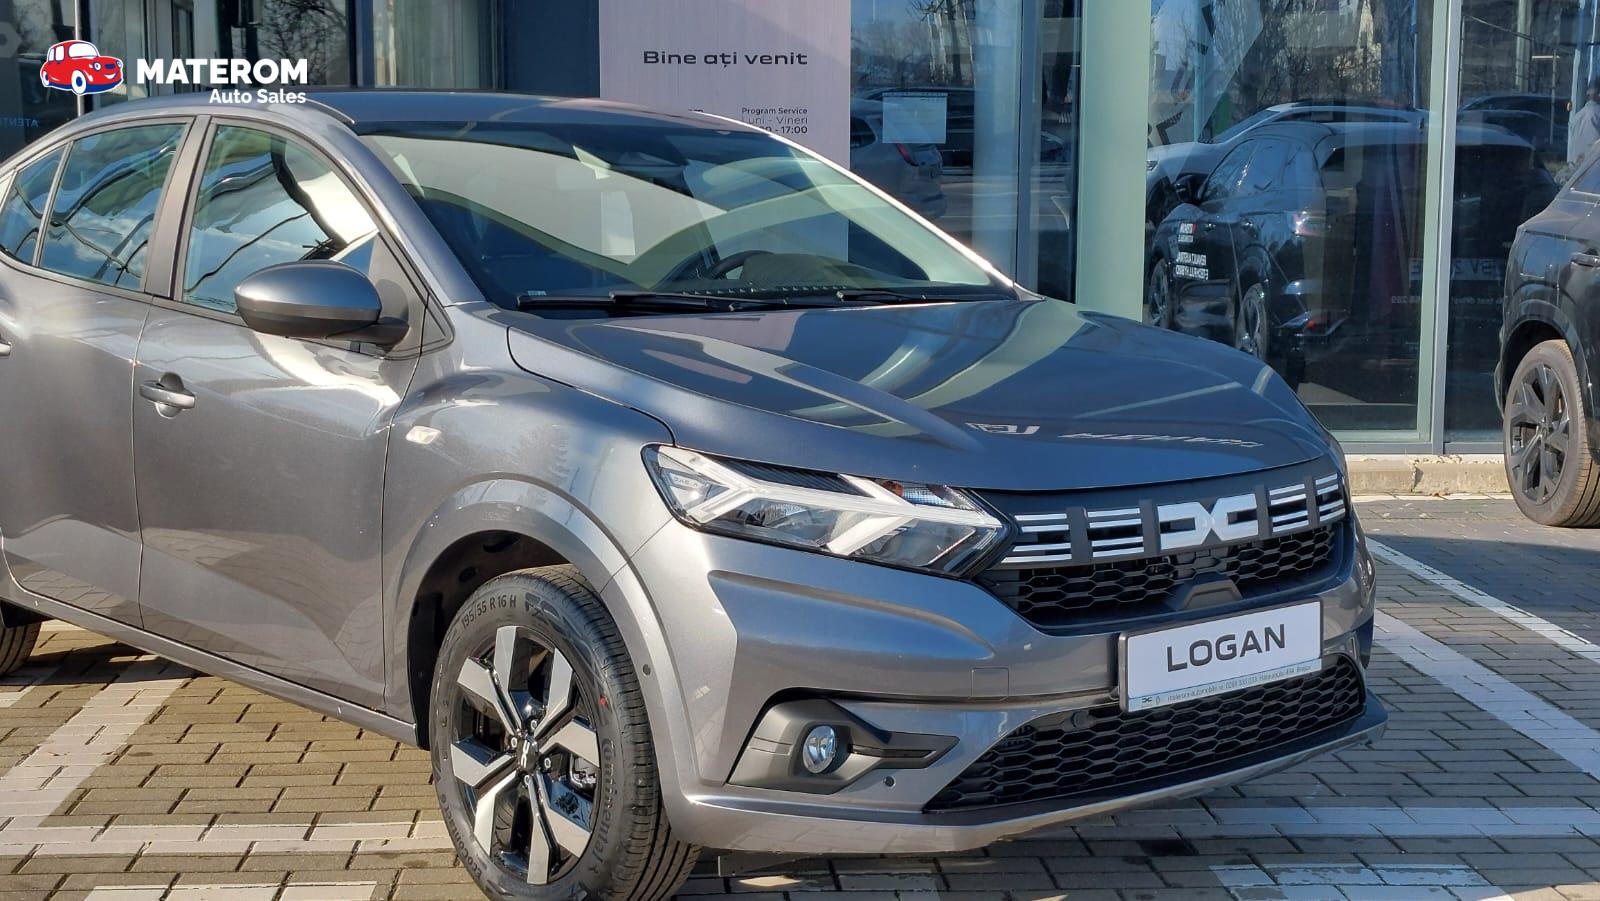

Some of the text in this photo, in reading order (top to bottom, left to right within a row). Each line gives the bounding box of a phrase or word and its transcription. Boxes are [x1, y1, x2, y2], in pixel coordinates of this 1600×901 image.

[643, 50, 697, 65] Bine
[744, 52, 808, 66] venit
[741, 107, 808, 116] Program Service
[776, 116, 808, 125] Vineri
[781, 125, 808, 134] 17:00
[462, 594, 517, 629] 195/55 R 16 H
[1166, 623, 1286, 673] LOGAN
